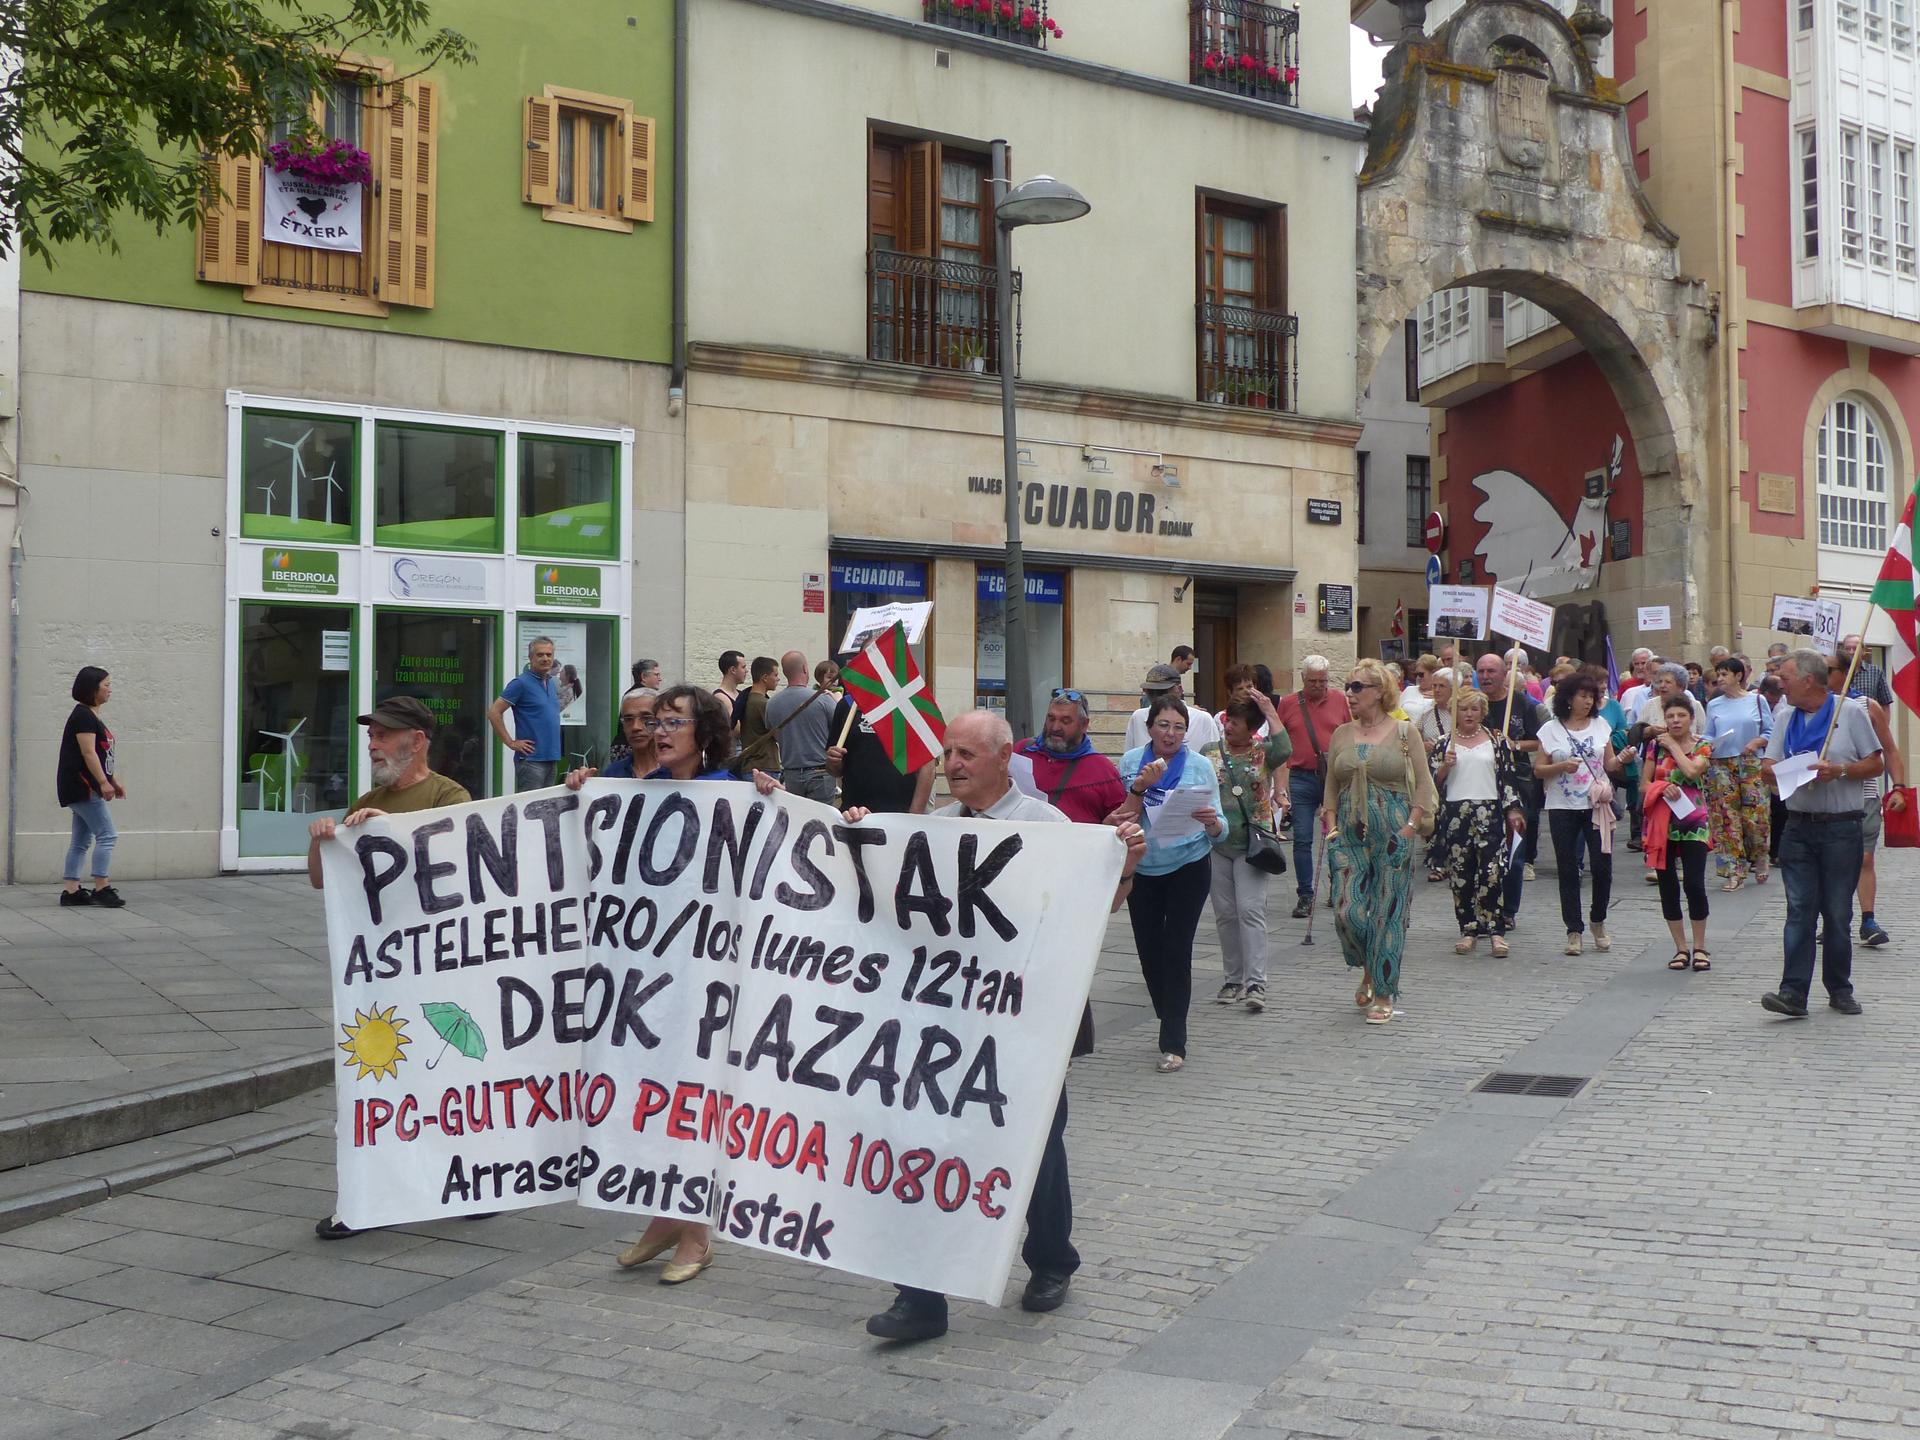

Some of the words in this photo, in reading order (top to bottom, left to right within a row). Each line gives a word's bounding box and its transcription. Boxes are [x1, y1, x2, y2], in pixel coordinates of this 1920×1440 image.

[282, 181, 315, 189] EUSKAL
[280, 216, 348, 238] ETXERA
[968, 476, 1002, 495] VIAJES
[1005, 481, 1155, 534] CUADOR
[1159, 520, 1194, 537] BIDAIAK
[272, 570, 336, 583] IBERDROLA
[844, 567, 905, 587] ECUADOR
[543, 585, 598, 597] IBERDROLA
[400, 655, 421, 667] Zure
[395, 669, 415, 682] izan
[417, 671, 438, 683] nahi
[441, 671, 464, 684] dugu
[354, 791, 1023, 942] PENTSIONISTAK
[750, 914, 889, 994] lunes
[901, 945, 1023, 1017] 12tan
[696, 980, 1007, 1128] PLAZARA
[843, 1132, 1011, 1220] 1080€
